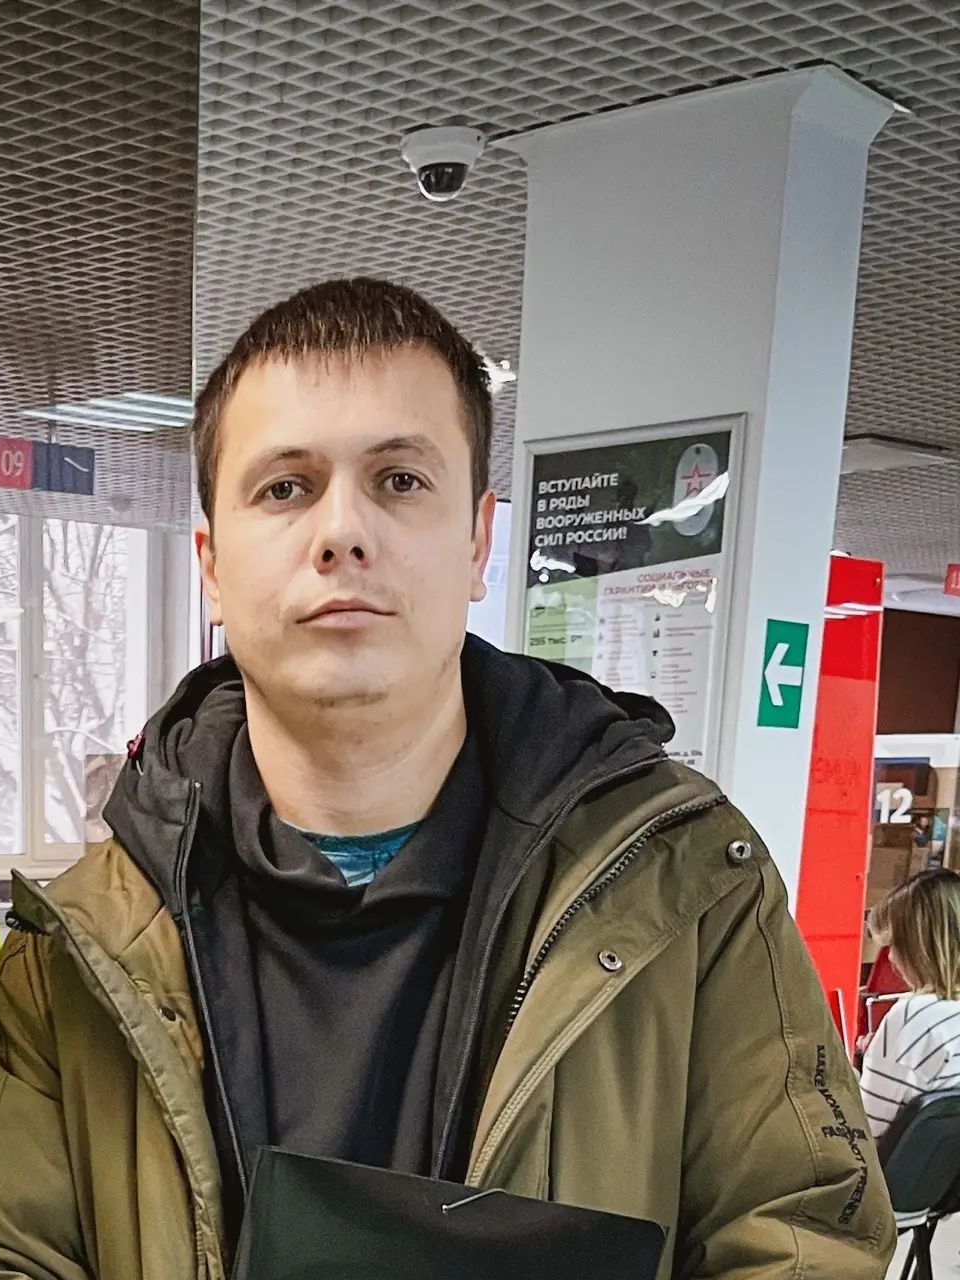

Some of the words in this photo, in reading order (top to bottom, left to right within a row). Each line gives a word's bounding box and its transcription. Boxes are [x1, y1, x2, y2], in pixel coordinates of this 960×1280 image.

[1, 449, 25, 477] 09
[538, 472, 619, 494] ВСТУПАЙТЕ
[537, 499, 547, 512] В
[549, 495, 590, 511] РЯДЫ
[536, 506, 647, 530] ВООРУЖЕННЫХ
[534, 532, 563, 547] СИЛ
[565, 526, 628, 545] РОССИИ!
[876, 788, 913, 824] 12
